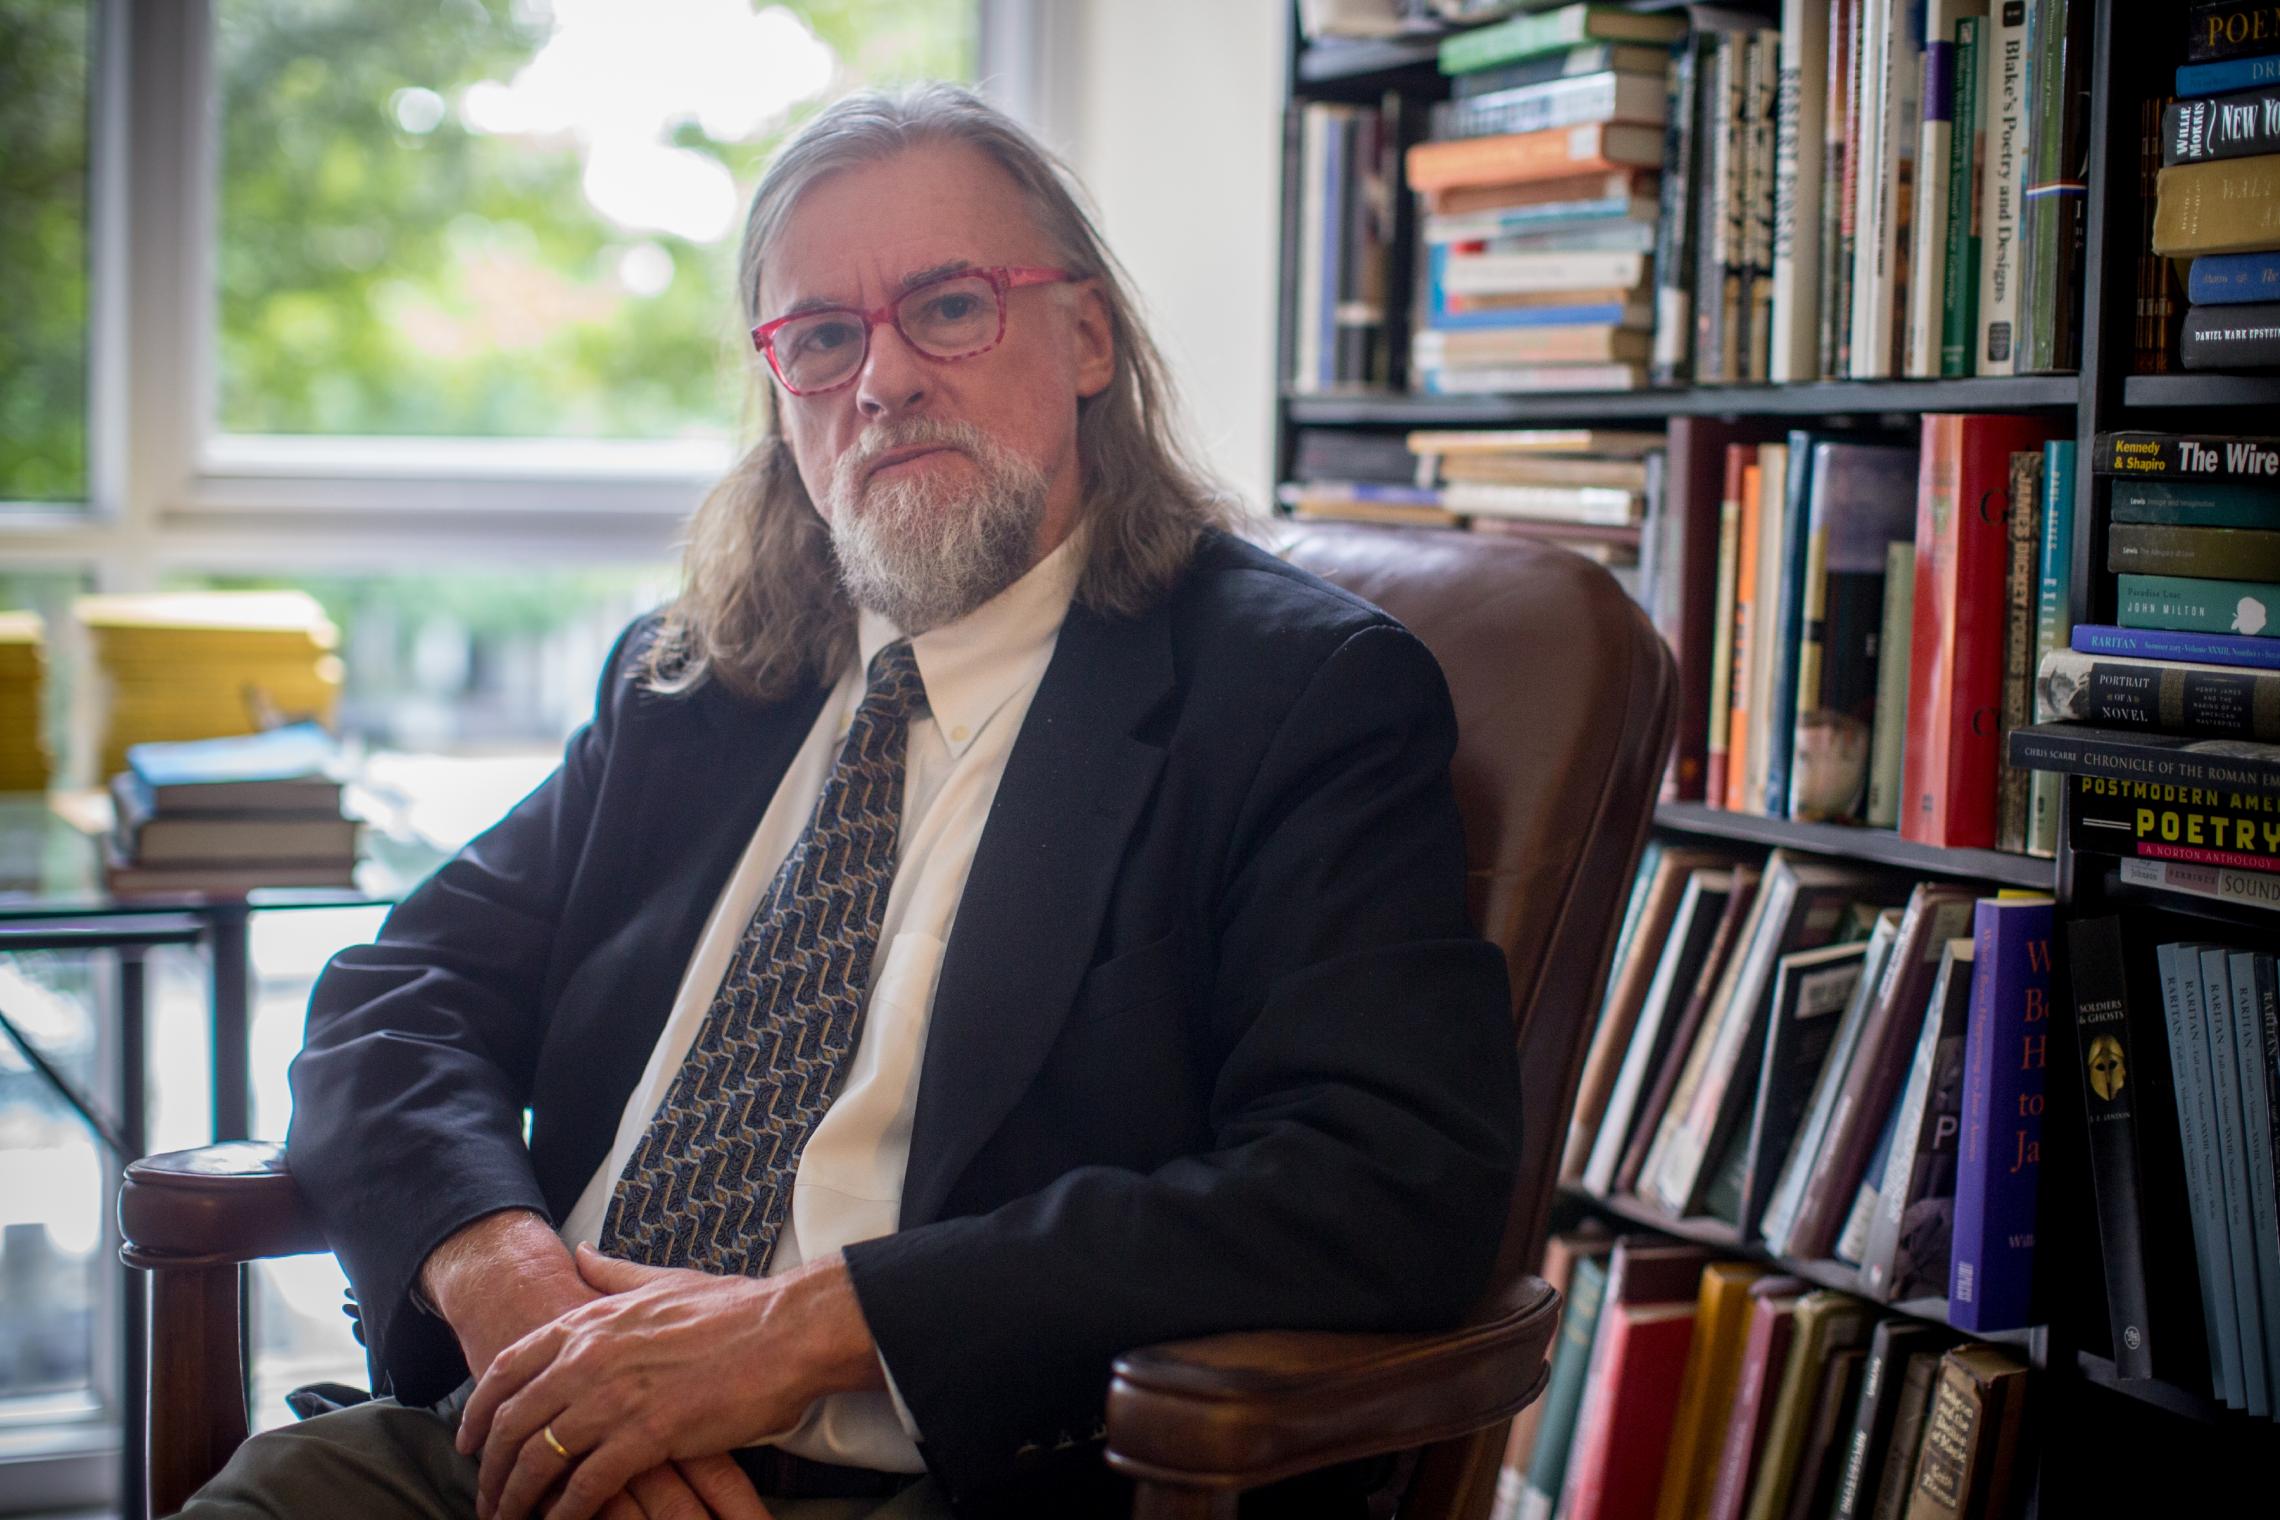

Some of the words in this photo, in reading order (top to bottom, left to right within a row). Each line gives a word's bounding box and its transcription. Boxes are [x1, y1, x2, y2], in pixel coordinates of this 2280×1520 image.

[2003, 39, 2021, 114] Blake's
[2176, 106, 2191, 156] WILLIE
[2190, 102, 2205, 158] MORRIS
[2221, 104, 2258, 142] NEW
[1999, 116, 2018, 181] Poetry
[1998, 186, 2014, 221] and
[1993, 226, 2013, 304] Designs
[2195, 330, 2223, 342] DANIEL
[2224, 329, 2247, 340] MARK
[2116, 440, 2160, 456] Kennedy
[2178, 441, 2219, 473] The
[2226, 442, 2280, 474] Wire
[2114, 456, 2123, 469] &
[2126, 457, 2167, 472] Shapiro
[2130, 497, 2146, 505] Lewis
[2122, 546, 2138, 554] Lewis
[2128, 588, 2161, 598] Paradise
[2127, 602, 2156, 614] JOHN
[2162, 604, 2205, 617] MILTON
[2091, 635, 2137, 649] RARITAN
[2100, 674, 2150, 688] PORTRAIT
[2114, 693, 2125, 702] OF
[2126, 694, 2133, 703] A
[2102, 706, 2149, 722] NOVEL
[2024, 747, 2047, 758] CHRIS
[2049, 750, 2077, 761] SCARRE
[2083, 752, 2155, 773] CHRONICLE
[2158, 761, 2176, 775] OF
[2178, 763, 2204, 778] THE
[2208, 768, 2257, 784] ROMAN
[2082, 776, 2218, 807] POSTMODERN
[2136, 807, 2280, 854] POETRY
[2145, 845, 2152, 855] A
[2156, 847, 2200, 860] NORTON
[2206, 853, 2272, 869] ANTHOLOGY
[2079, 999, 2122, 1013] SOLDIERS
[2079, 1014, 2087, 1025] &
[2087, 1010, 2125, 1024] GHOSTS
[2167, 977, 2181, 1036] RARITAN
[2185, 981, 2199, 1041] RARITAN
[2210, 984, 2224, 1045] RARITAN
[2239, 987, 2253, 1049] RARITAN
[2262, 991, 2279, 1057] RARITAN
[2017, 1093, 2045, 1118] to
[2103, 1111, 2131, 1121] LENDON
